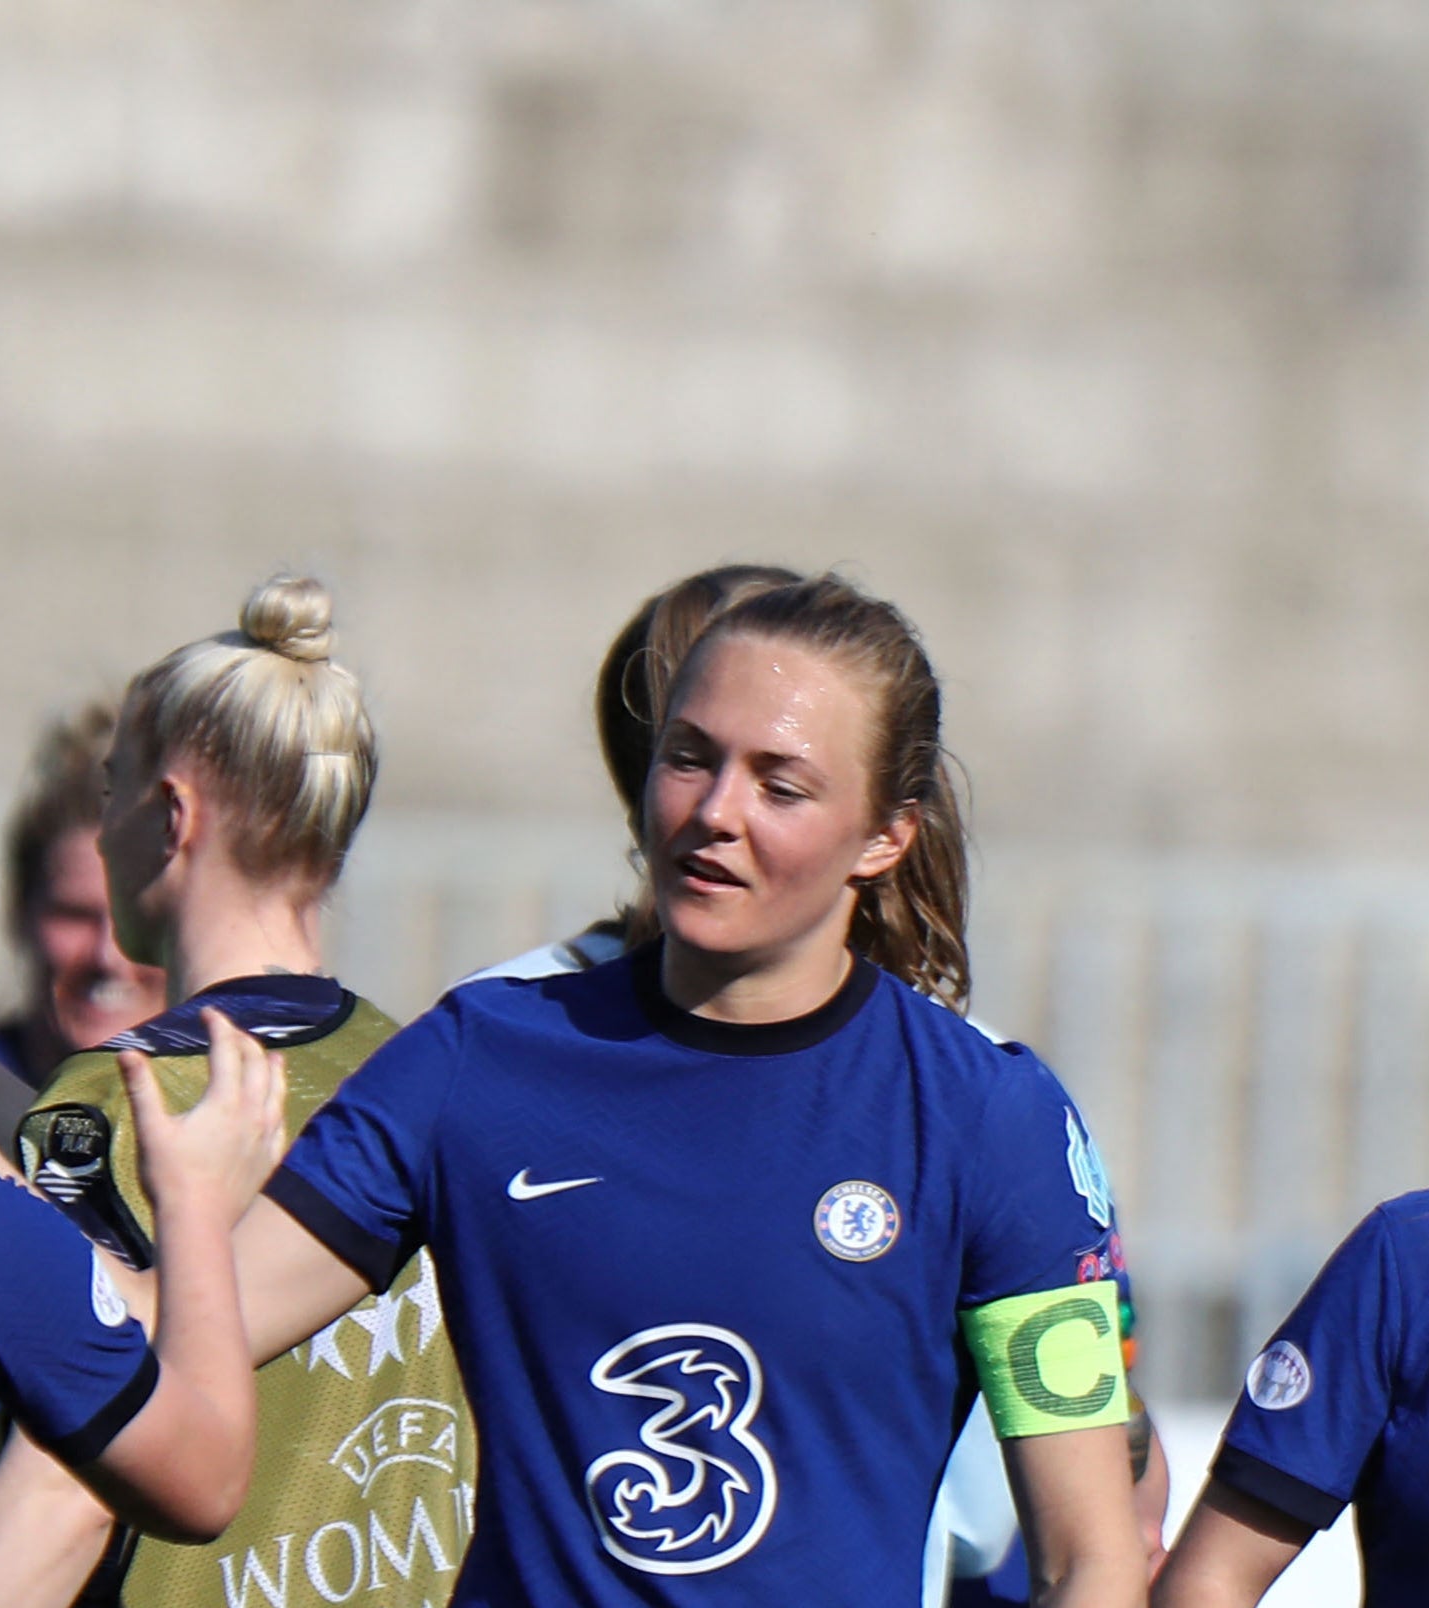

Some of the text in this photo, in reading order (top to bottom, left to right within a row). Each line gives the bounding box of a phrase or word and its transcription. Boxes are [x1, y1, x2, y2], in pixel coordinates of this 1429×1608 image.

[1007, 1298, 1117, 1417] C
[341, 1412, 457, 1485] UEFA
[585, 1323, 777, 1575] 3
